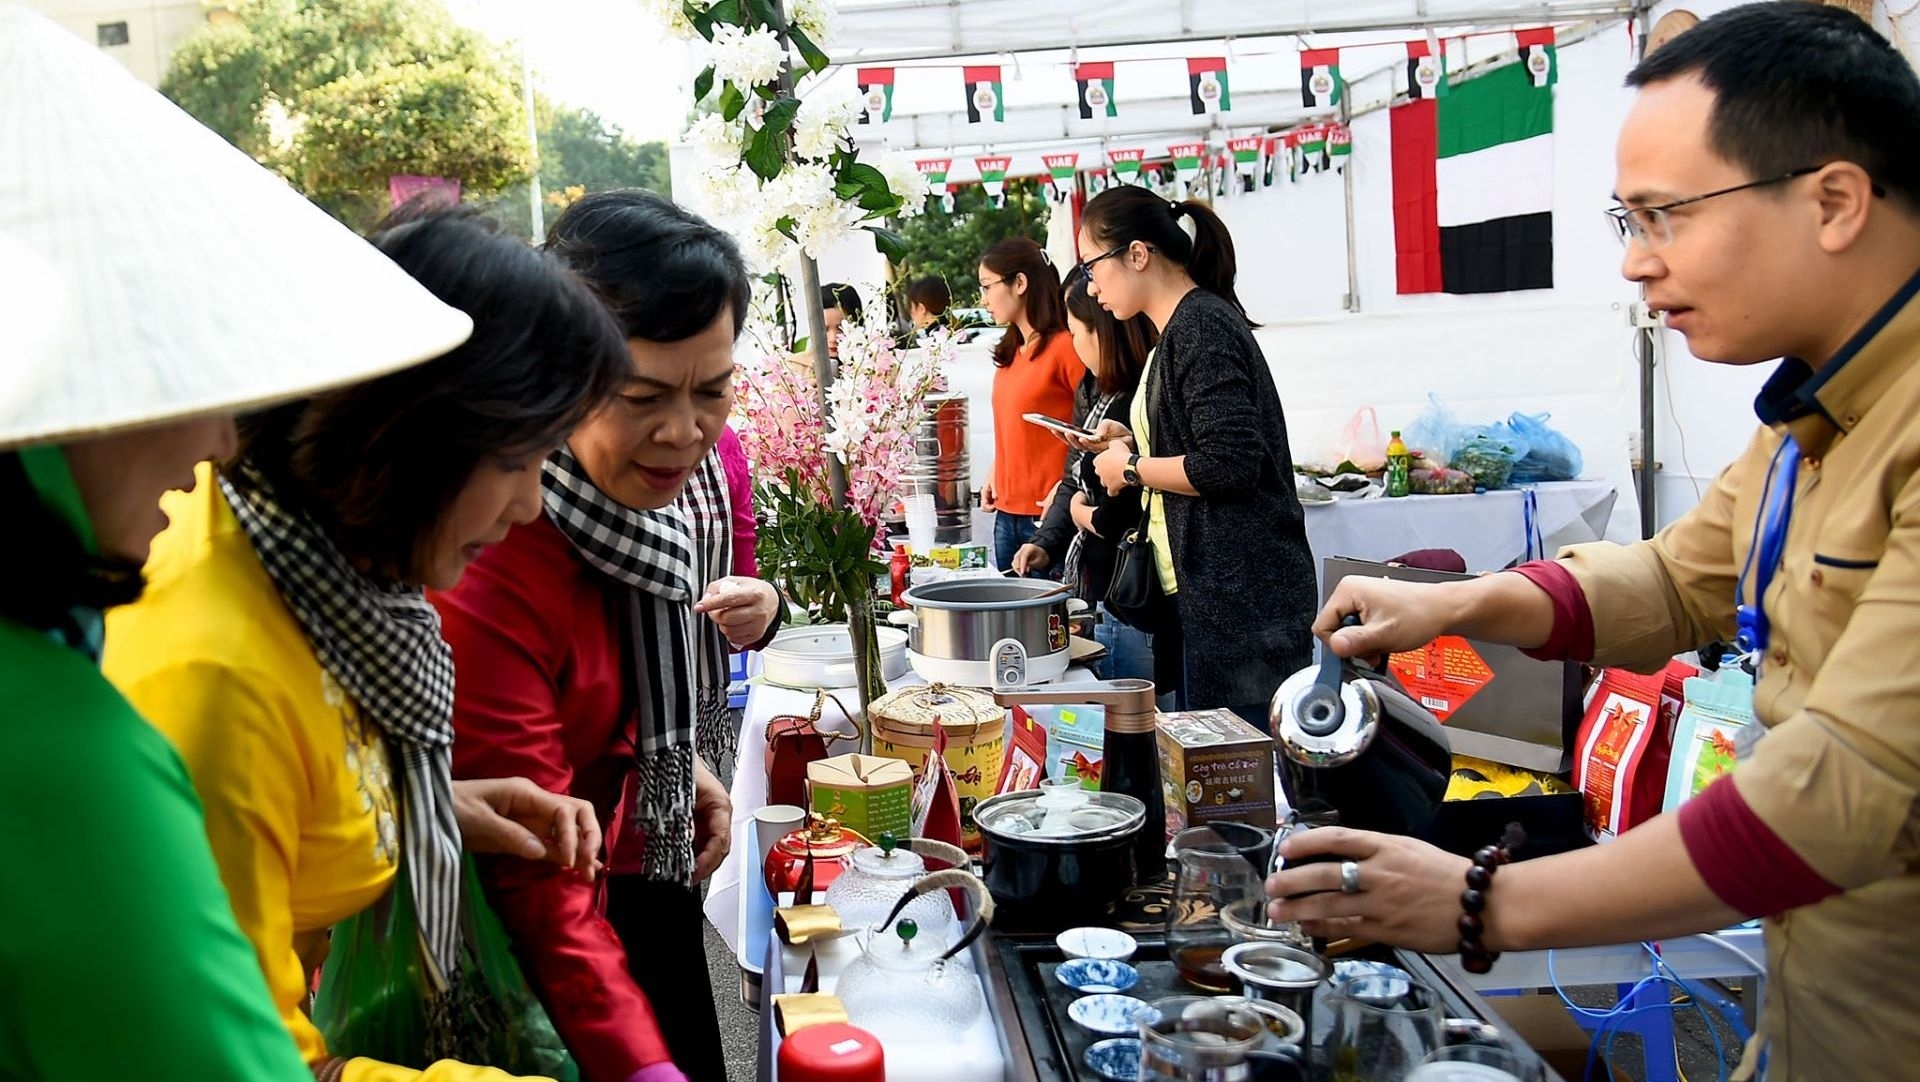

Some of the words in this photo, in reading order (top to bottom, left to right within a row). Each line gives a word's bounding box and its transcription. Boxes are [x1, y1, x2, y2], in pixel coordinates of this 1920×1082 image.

[1297, 131, 1322, 144] UAE
[1233, 139, 1257, 150] UAE
[1113, 151, 1138, 162] UAE
[1173, 146, 1198, 157] UAE
[981, 160, 1005, 171] UAE
[1047, 156, 1072, 166] UAE
[921, 162, 946, 172] UAE
